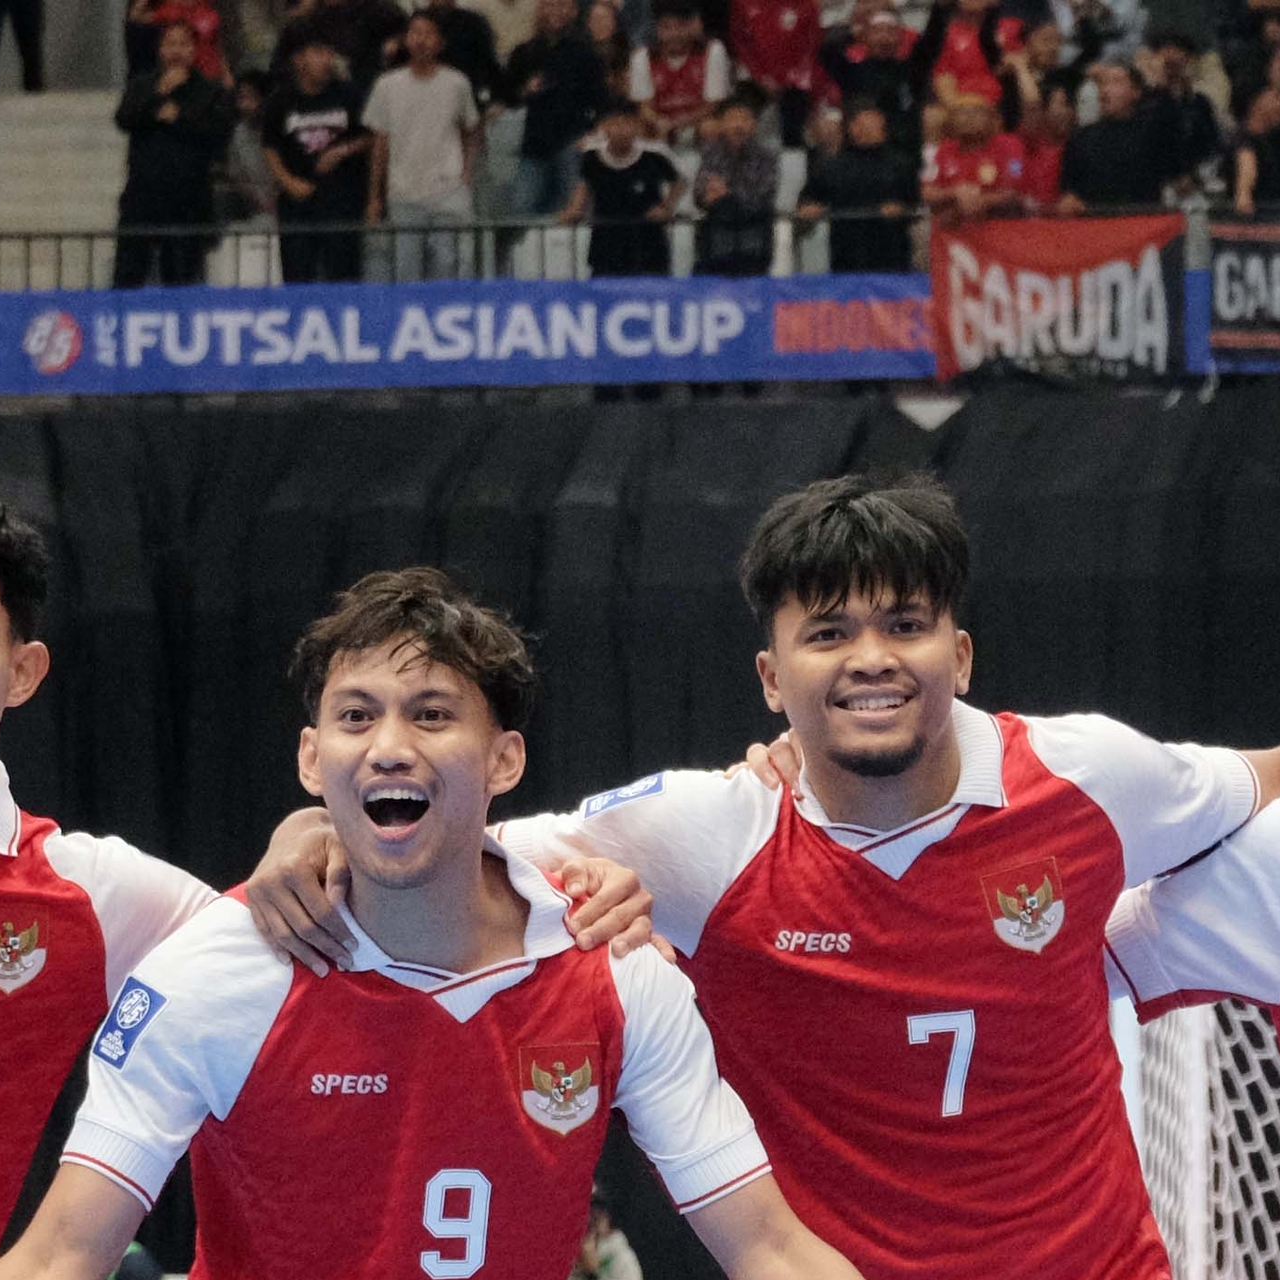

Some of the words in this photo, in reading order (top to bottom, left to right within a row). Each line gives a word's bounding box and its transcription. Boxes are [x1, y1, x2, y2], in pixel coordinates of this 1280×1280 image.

[124, 306, 381, 368] FUTSAL
[389, 300, 598, 362] ASIAN
[602, 296, 745, 358] CUP
[947, 243, 1169, 374] GARUDA
[774, 929, 852, 954] SPECS
[310, 1072, 389, 1096] SPECS
[906, 1009, 977, 1118] 7
[419, 1168, 493, 1280] 9
